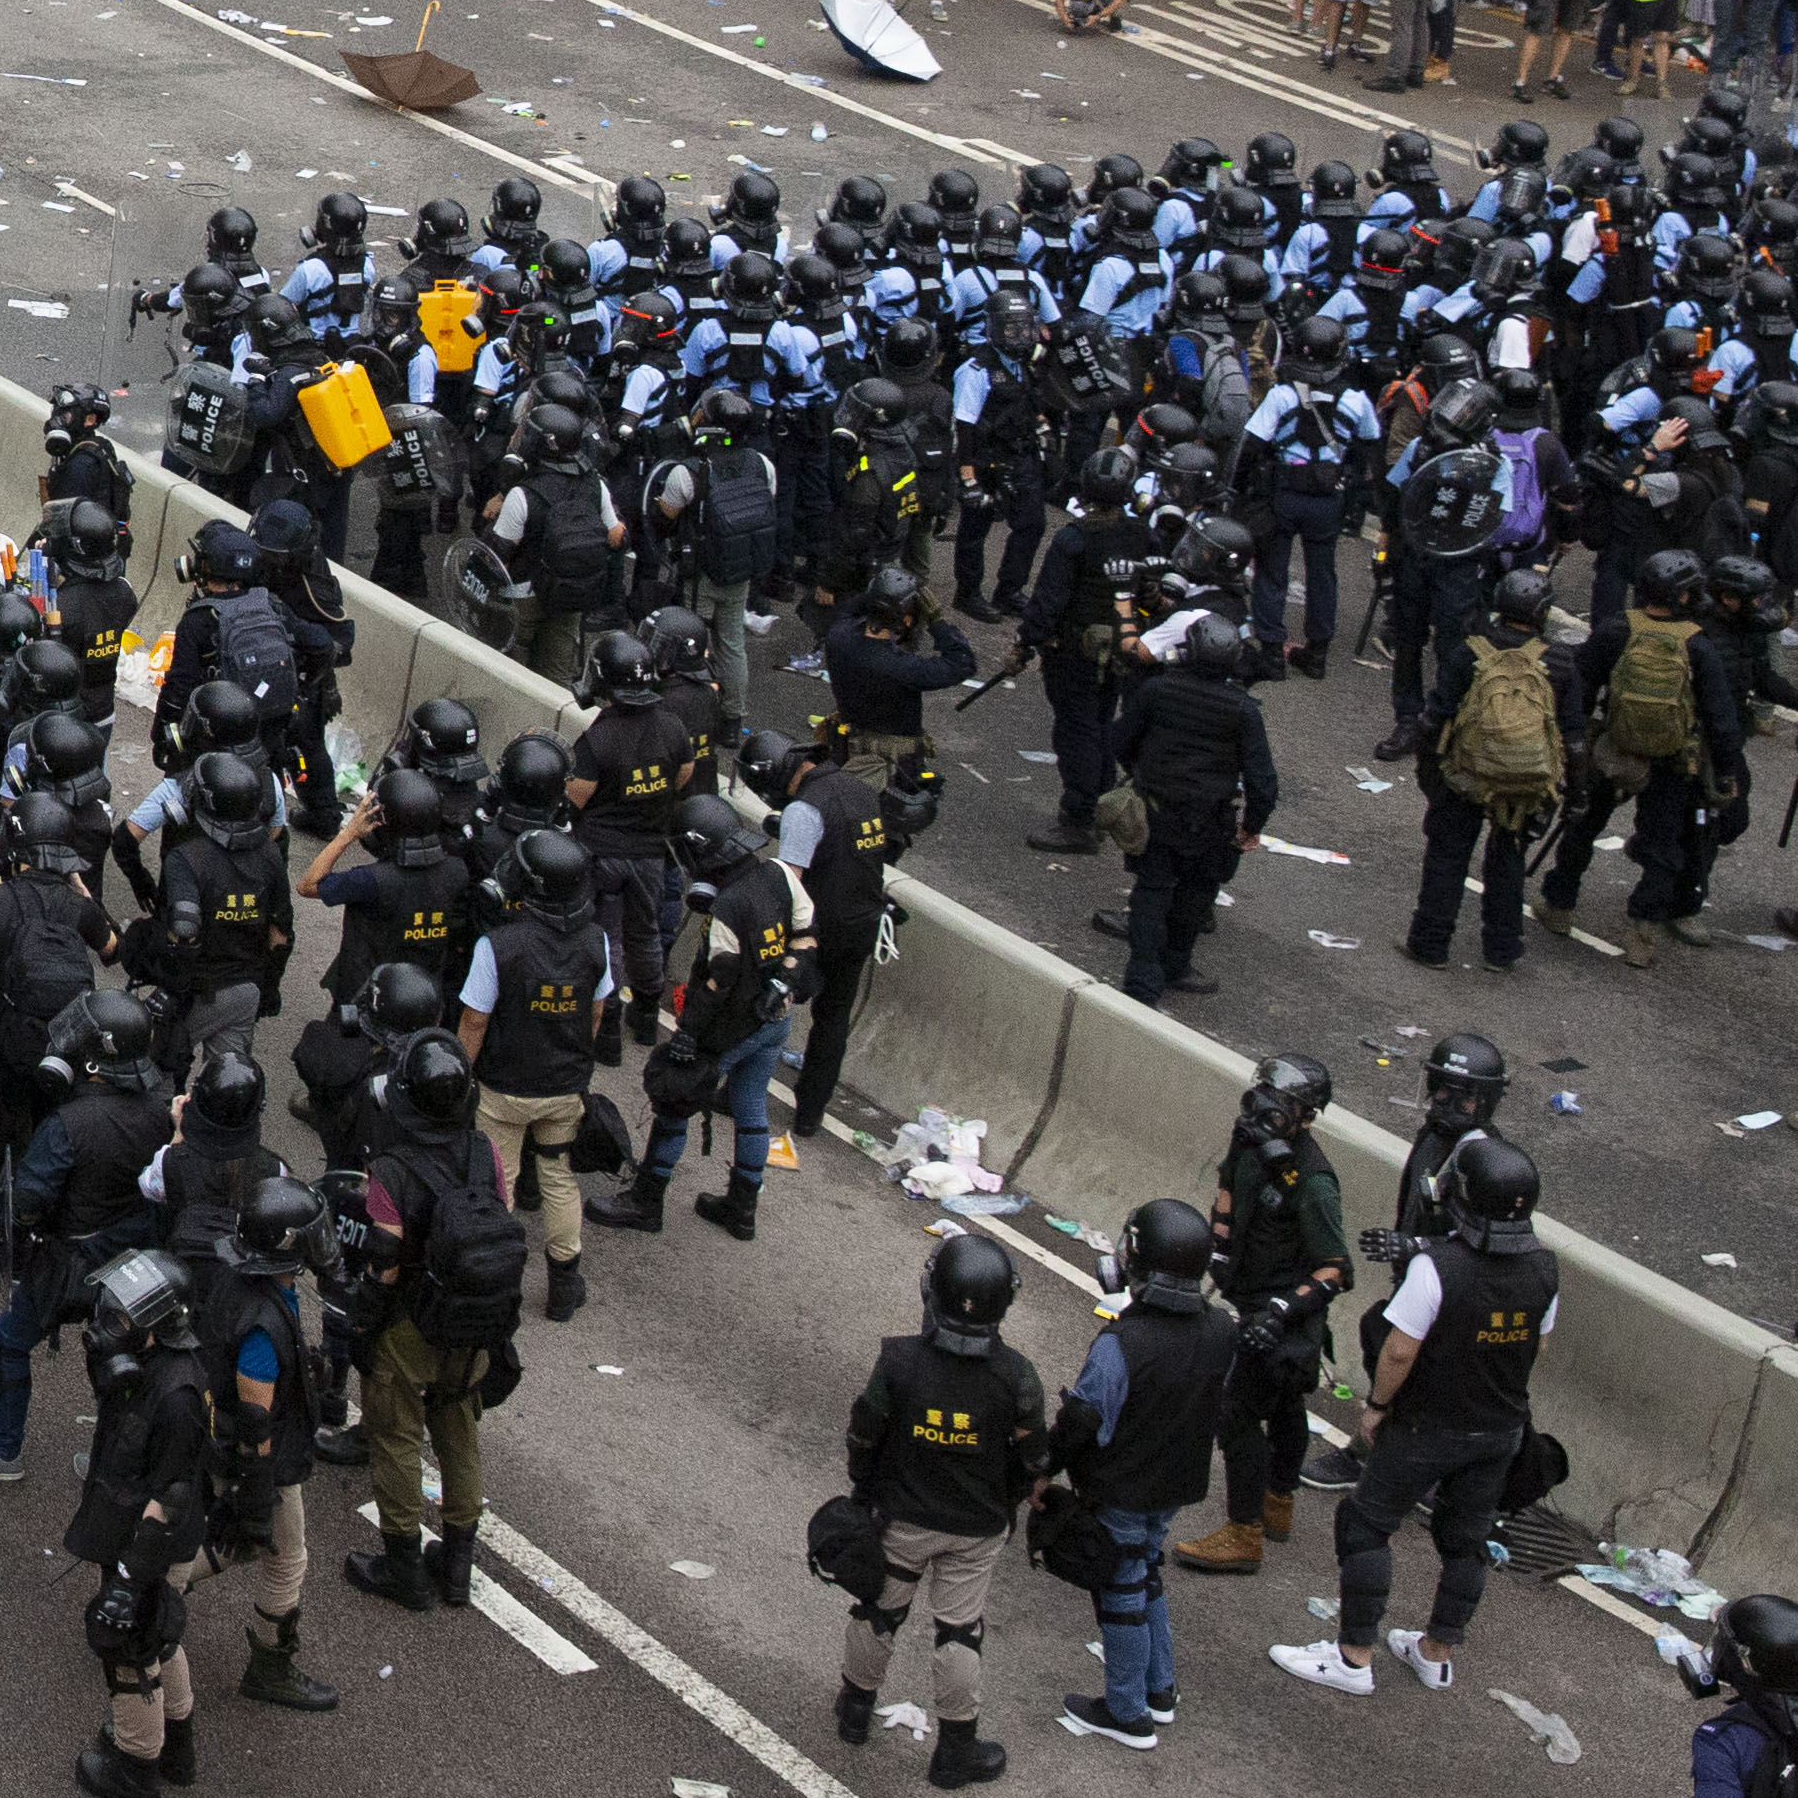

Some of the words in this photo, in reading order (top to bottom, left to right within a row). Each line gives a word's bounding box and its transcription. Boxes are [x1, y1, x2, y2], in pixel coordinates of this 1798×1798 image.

[1074, 334, 1111, 391] POLICE
[200, 395, 224, 454] POLICE
[405, 429, 432, 488] POLICE
[1461, 492, 1490, 529] POLICE
[86, 642, 121, 659] POLICE
[625, 777, 668, 797] POLICE
[215, 909, 259, 923] POLICE
[404, 927, 448, 941] POLICE
[530, 999, 578, 1014] POLICE
[336, 1213, 368, 1250] LICE
[1476, 1328, 1530, 1344] POLICE
[913, 1425, 979, 1446] POLICE
